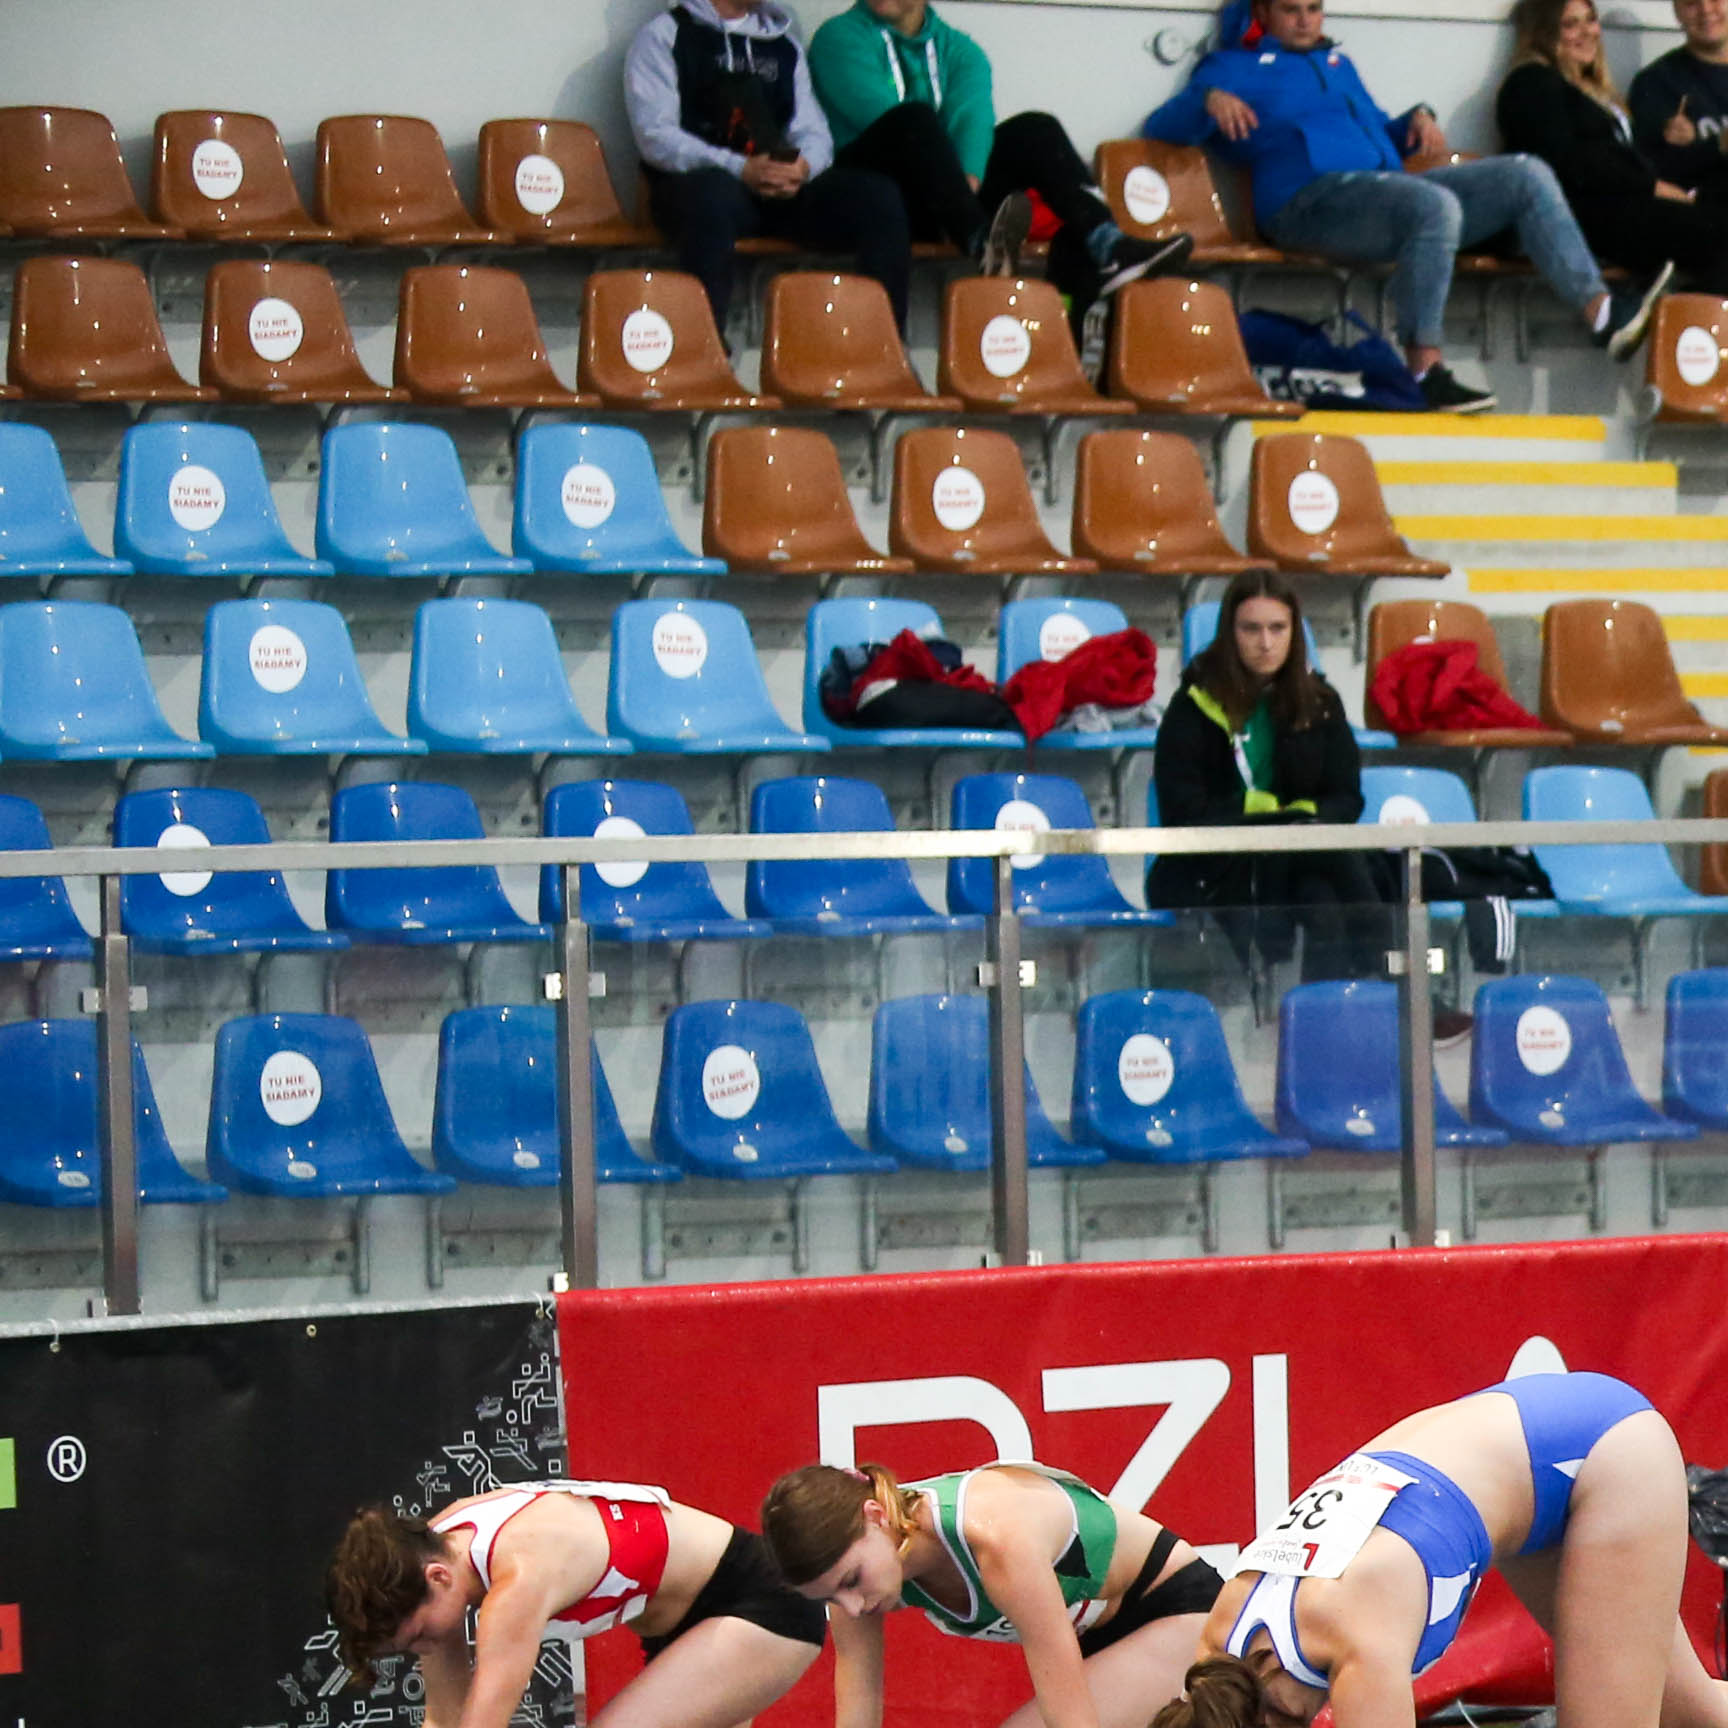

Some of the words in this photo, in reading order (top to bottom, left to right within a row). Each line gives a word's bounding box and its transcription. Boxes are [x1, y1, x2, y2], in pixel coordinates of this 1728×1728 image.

[257, 319, 268, 327] TU
[254, 329, 297, 340] SIADAMY
[177, 487, 190, 496] TU
[193, 487, 211, 495] NIE
[570, 483, 582, 492] TU
[585, 486, 602, 495] NIE
[174, 498, 219, 509] SIADAMY
[660, 633, 672, 643] TU
[675, 634, 692, 643] NIE
[257, 647, 270, 656] TU
[273, 647, 292, 656] NIE
[255, 659, 301, 669] SIADAMY
[268, 1077, 282, 1088] TU
[285, 1075, 305, 1087] NIE
[710, 1076, 724, 1086] TU
[728, 1070, 745, 1082] NIE
[266, 1087, 315, 1102] SIADAMY
[709, 1080, 755, 1102] SIADAMY
[1276, 1489, 1343, 1530] 35
